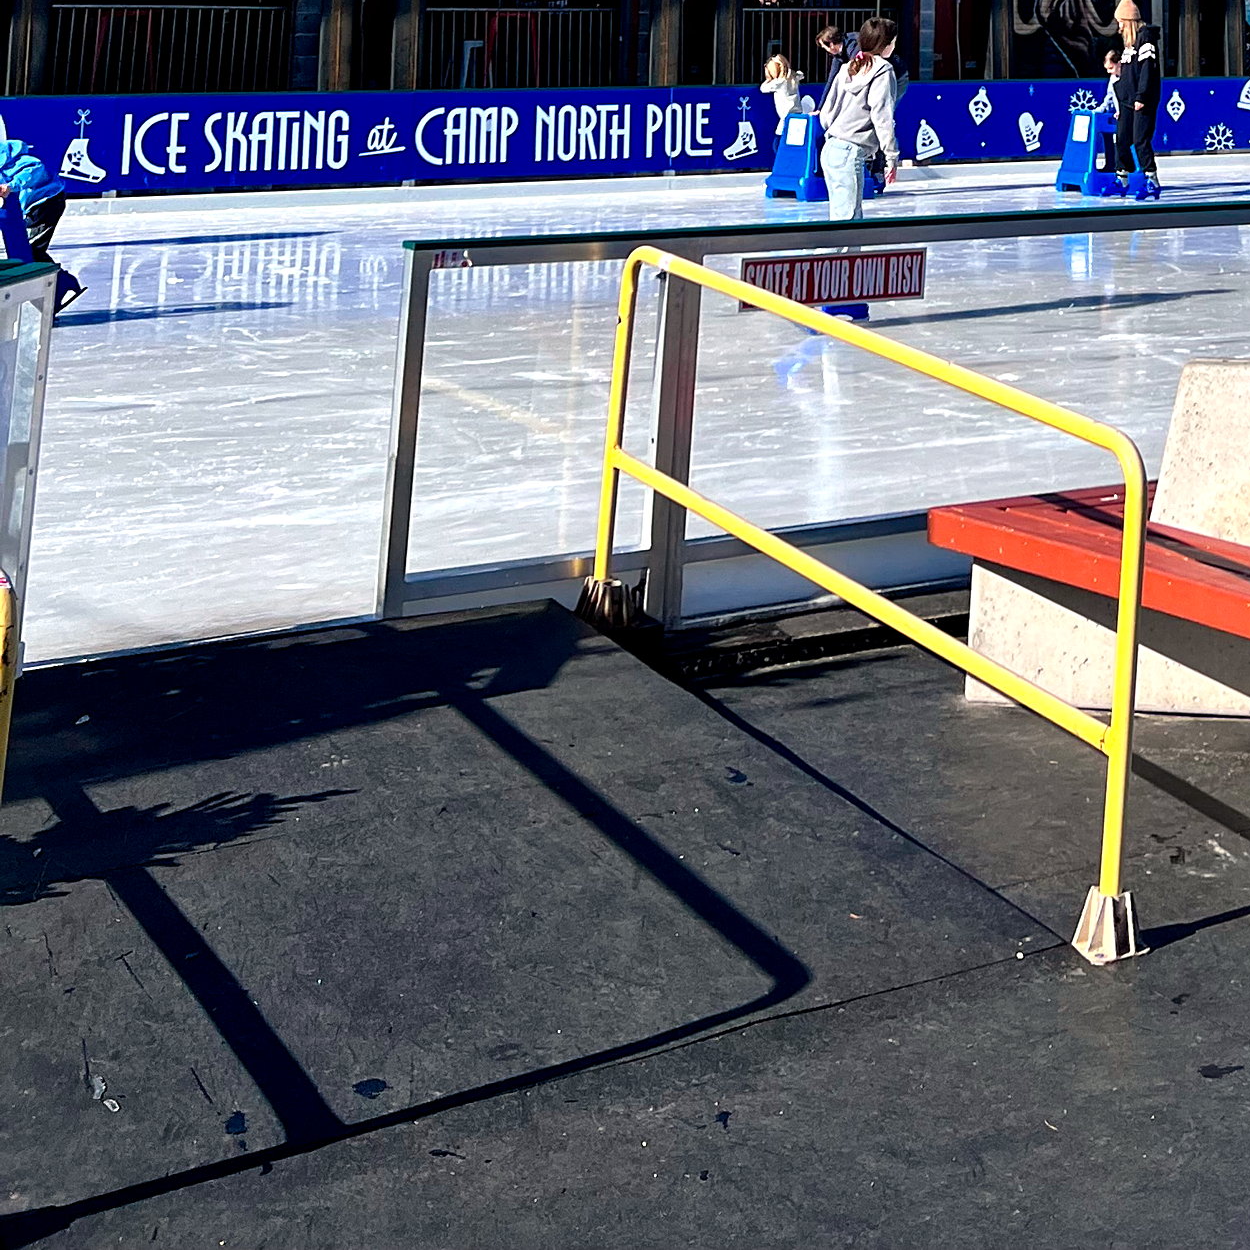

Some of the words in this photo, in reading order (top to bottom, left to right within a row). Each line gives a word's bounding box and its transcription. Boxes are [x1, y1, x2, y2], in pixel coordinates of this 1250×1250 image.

[122, 113, 189, 175] ICE
[205, 110, 349, 173] SKATING
[364, 116, 401, 154] at
[415, 106, 518, 166] CAMP
[535, 104, 630, 162] NORTH
[646, 102, 713, 158] POLE
[792, 261, 810, 301] AT
[813, 260, 850, 300] YOUR
[852, 257, 886, 298] OWN
[888, 254, 922, 295] RISK
